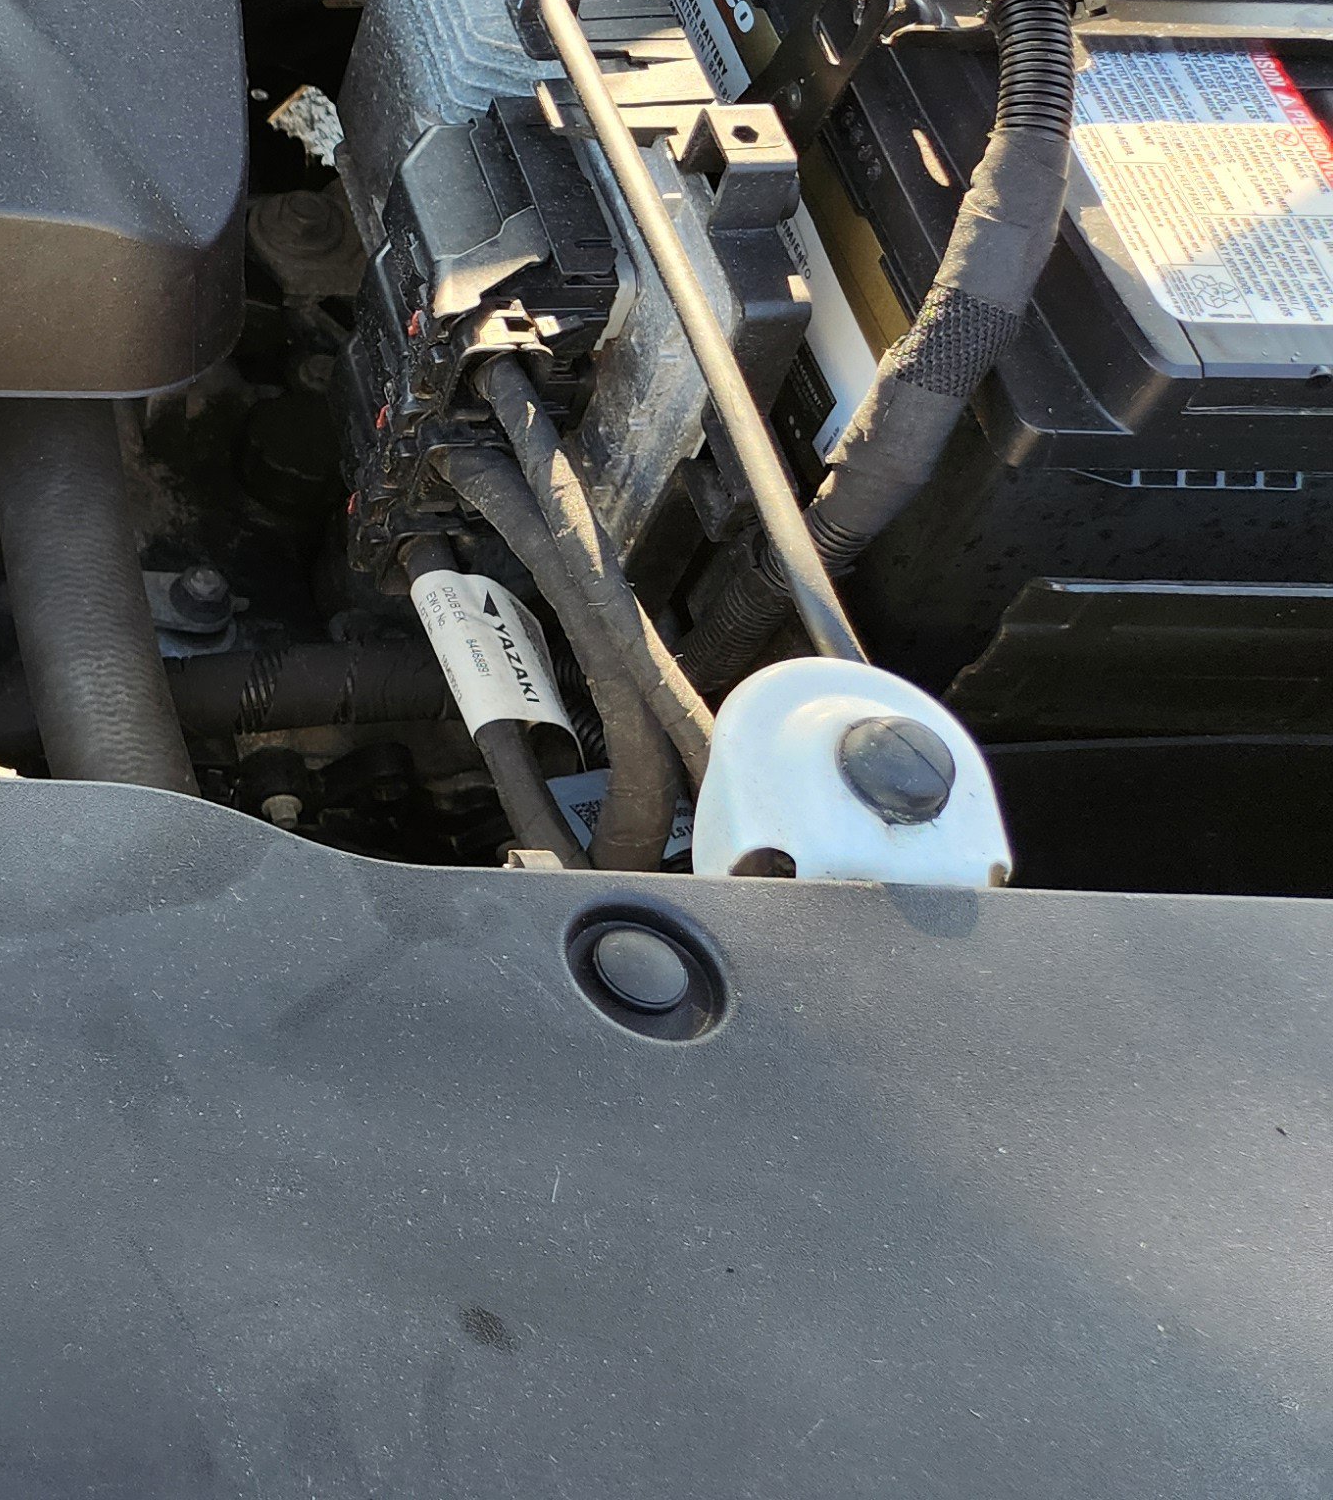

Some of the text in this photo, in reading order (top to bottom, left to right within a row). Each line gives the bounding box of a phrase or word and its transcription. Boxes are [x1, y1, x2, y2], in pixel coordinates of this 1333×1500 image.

[699, 19, 728, 76] BATTERY
[1200, 74, 1217, 88] LOS
[1219, 66, 1236, 80] LES
[1242, 105, 1261, 119] LES
[1227, 60, 1250, 82] CAUSE
[1243, 67, 1277, 107] EXPLOSIVE
[494, 622, 540, 703] YAZAKI
